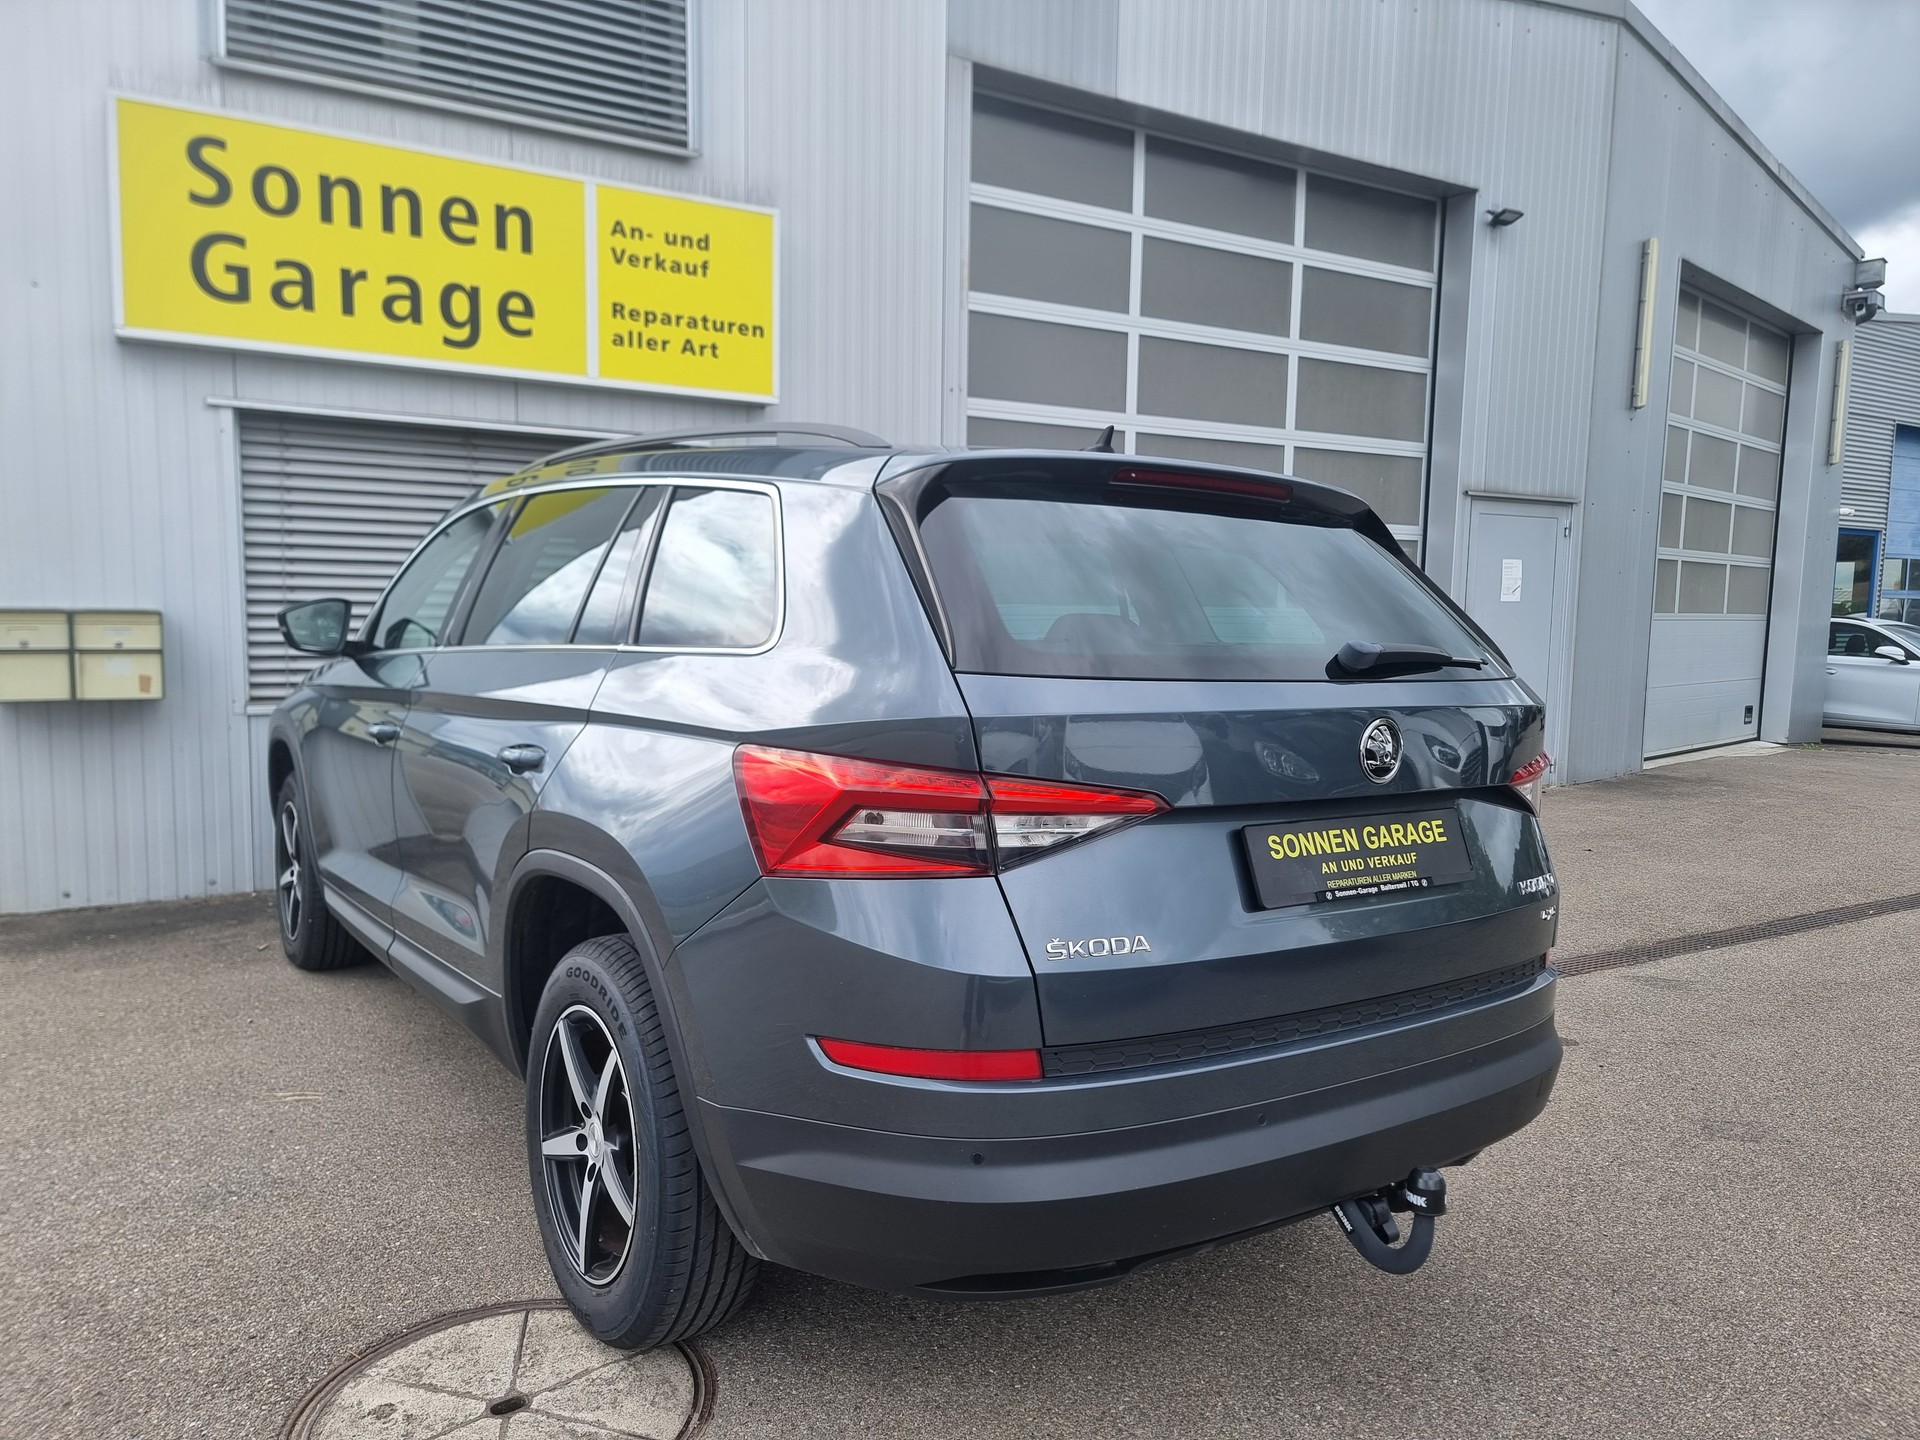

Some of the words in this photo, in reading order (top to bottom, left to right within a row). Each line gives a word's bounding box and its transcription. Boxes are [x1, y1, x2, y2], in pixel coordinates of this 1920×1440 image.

[187, 136, 533, 254] Sonnen
[611, 219, 655, 242] An-
[664, 232, 711, 252] und
[611, 247, 711, 279] Verkauf
[191, 233, 536, 350] Garage
[612, 302, 766, 340] Reparaturen
[612, 328, 671, 354] aller
[681, 339, 720, 360] Art
[1268, 829, 1359, 860] SONNEN
[1363, 820, 1447, 849] GARAGE
[1321, 863, 1337, 874] AN
[1341, 859, 1364, 872] UND
[1366, 852, 1417, 870] VERKAUF
[1327, 875, 1372, 889] REPARATUREN
[1373, 872, 1393, 883] ALLER
[1393, 870, 1417, 881] MARKEN
[1335, 886, 1378, 898] Sonnen-Garage
[1046, 935, 1151, 961] ŠKODA
[566, 966, 627, 1040] GOODRIDE
